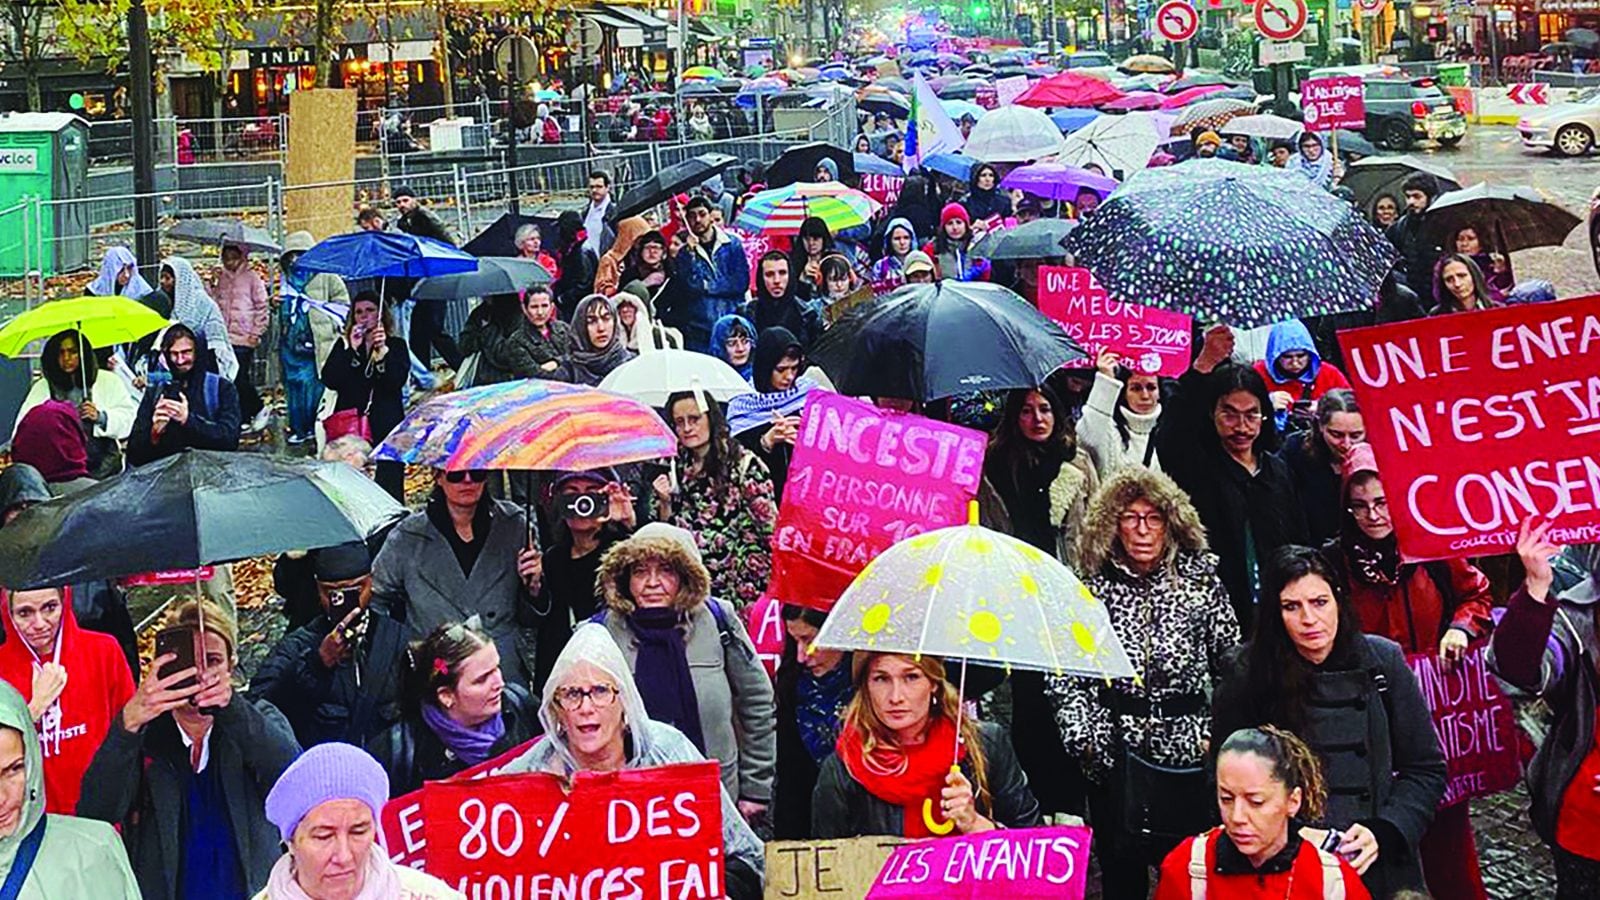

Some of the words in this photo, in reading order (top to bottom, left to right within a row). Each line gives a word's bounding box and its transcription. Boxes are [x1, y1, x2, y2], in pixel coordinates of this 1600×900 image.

[261, 47, 356, 65] INDINA
[1047, 271, 1080, 293] UN.E
[1088, 321, 1122, 341] LES
[1129, 325, 1142, 341] 5
[1142, 325, 1191, 346] JOURS
[802, 402, 982, 487] INCESTE
[1389, 389, 1546, 452] N'EST
[790, 465, 813, 500] 1
[818, 470, 948, 522] PERSONNE
[1407, 455, 1600, 536] CONSEN
[778, 525, 814, 553] EN
[821, 506, 871, 537] SUR
[1449, 528, 1519, 551] COLLECTIF
[607, 792, 701, 844] DES
[777, 846, 843, 897] JE
[882, 847, 935, 885] LES
[943, 837, 1080, 884] ENFANTS
